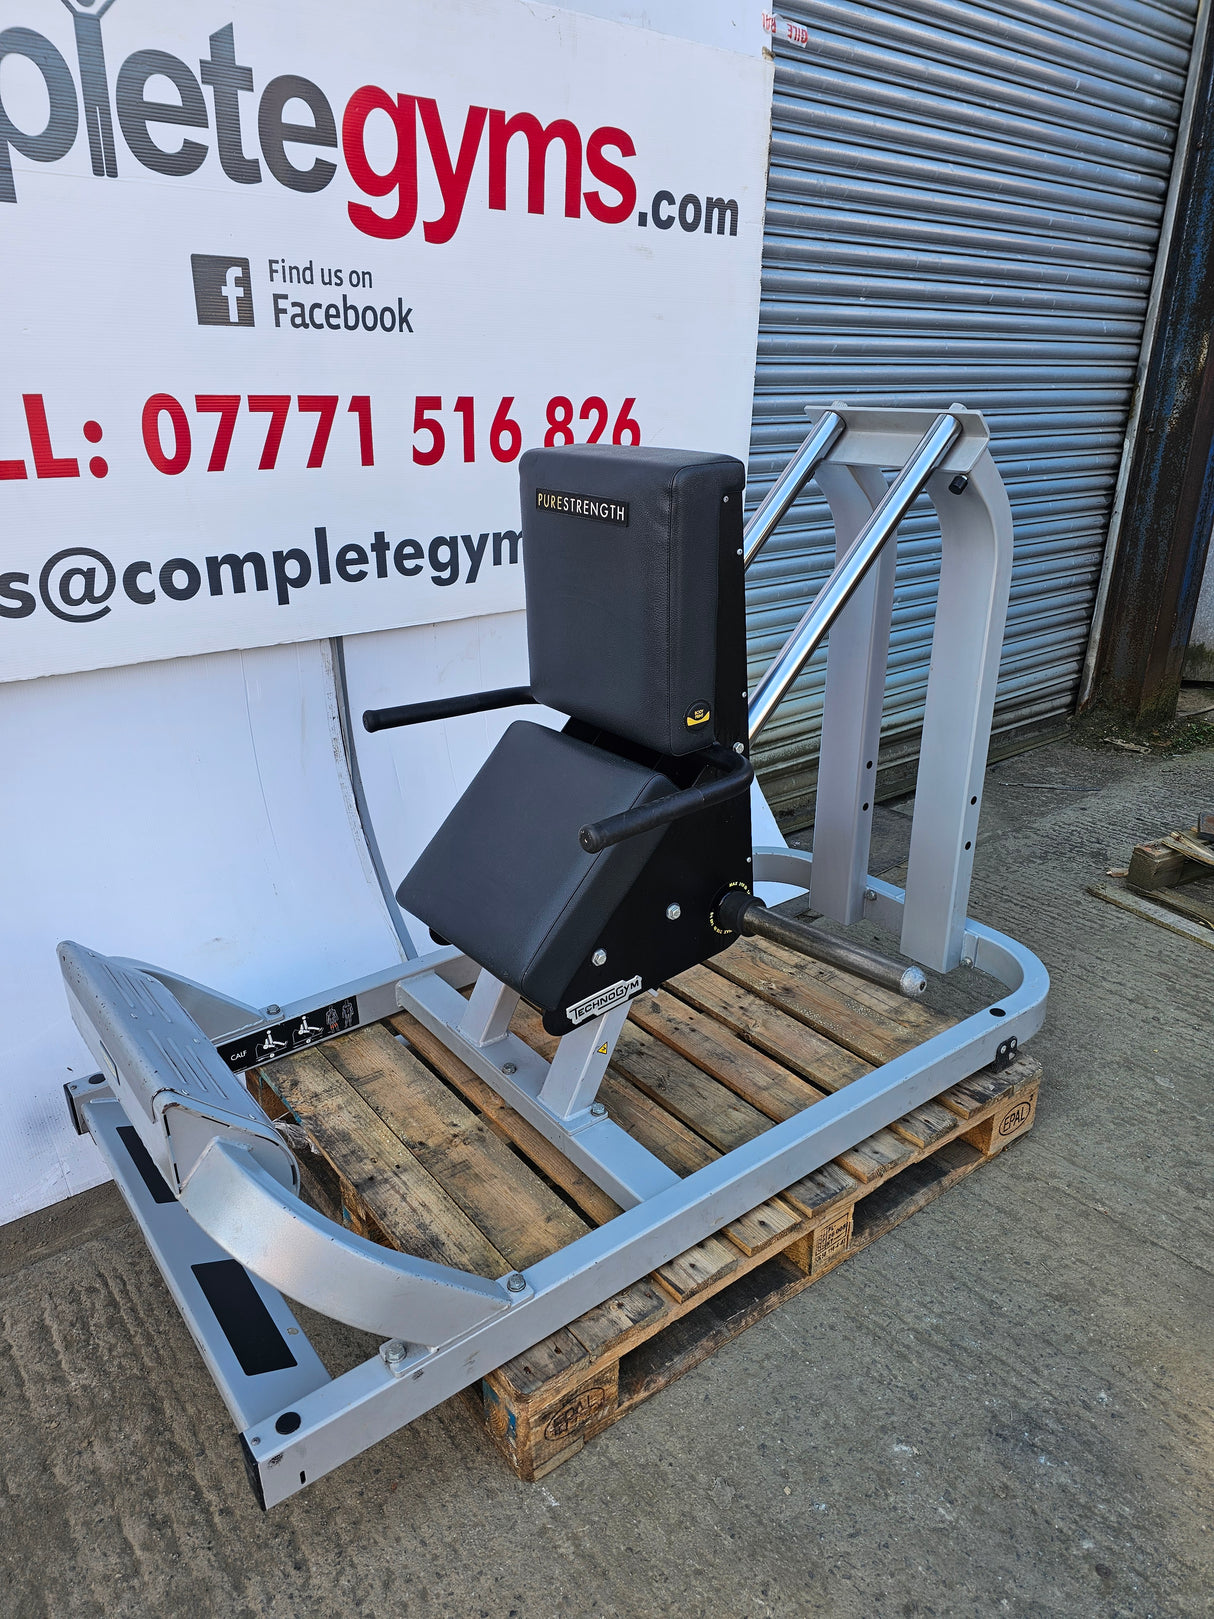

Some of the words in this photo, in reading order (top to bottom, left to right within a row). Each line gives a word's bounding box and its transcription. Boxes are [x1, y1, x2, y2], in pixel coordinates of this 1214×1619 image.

[268, 259, 314, 286] Find
[321, 267, 344, 288] us
[349, 268, 373, 289] on
[272, 292, 414, 334] Facebook
[141, 392, 375, 476] 07771
[412, 395, 522, 467] 516
[543, 395, 642, 448] 826
[538, 493, 625, 521] PURESTRENGTH
[230, 1049, 248, 1062] CALF
[1003, 1106, 1025, 1133] EPAL
